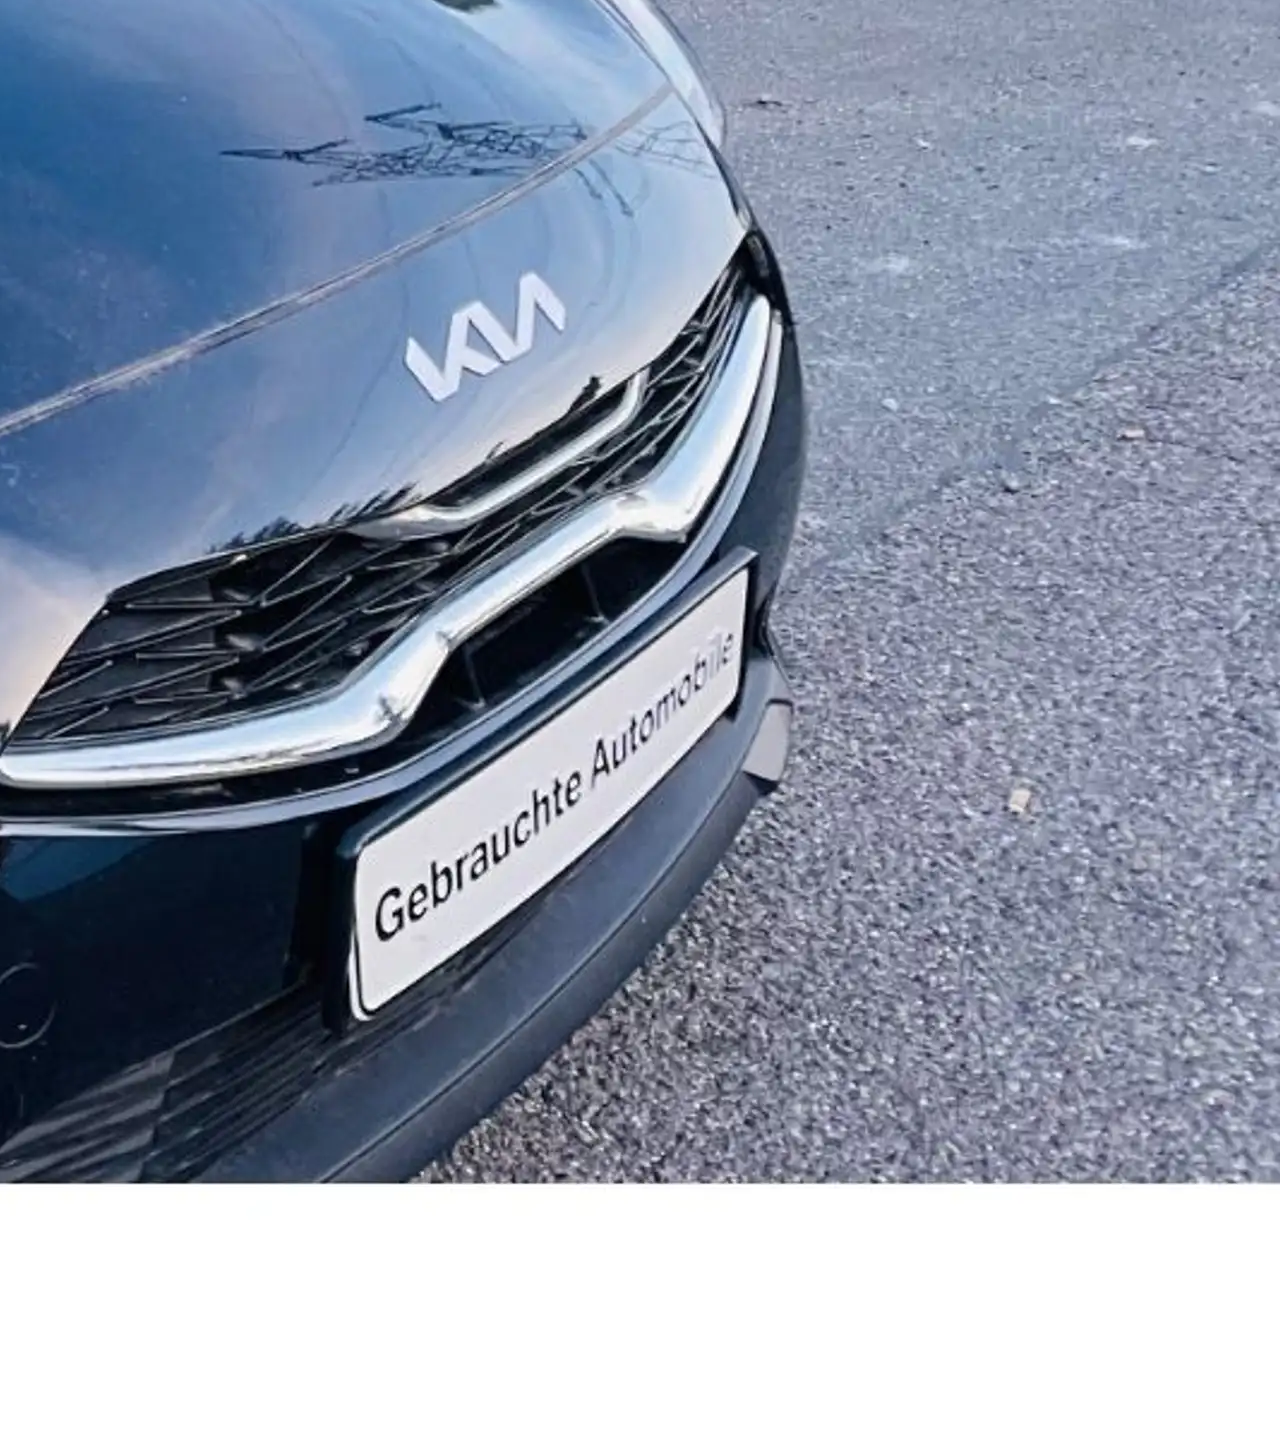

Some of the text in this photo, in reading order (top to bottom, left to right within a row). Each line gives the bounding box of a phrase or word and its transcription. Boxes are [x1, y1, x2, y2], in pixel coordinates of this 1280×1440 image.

[405, 271, 566, 402] KIA
[375, 628, 735, 942] Gebrauchte Automobile
